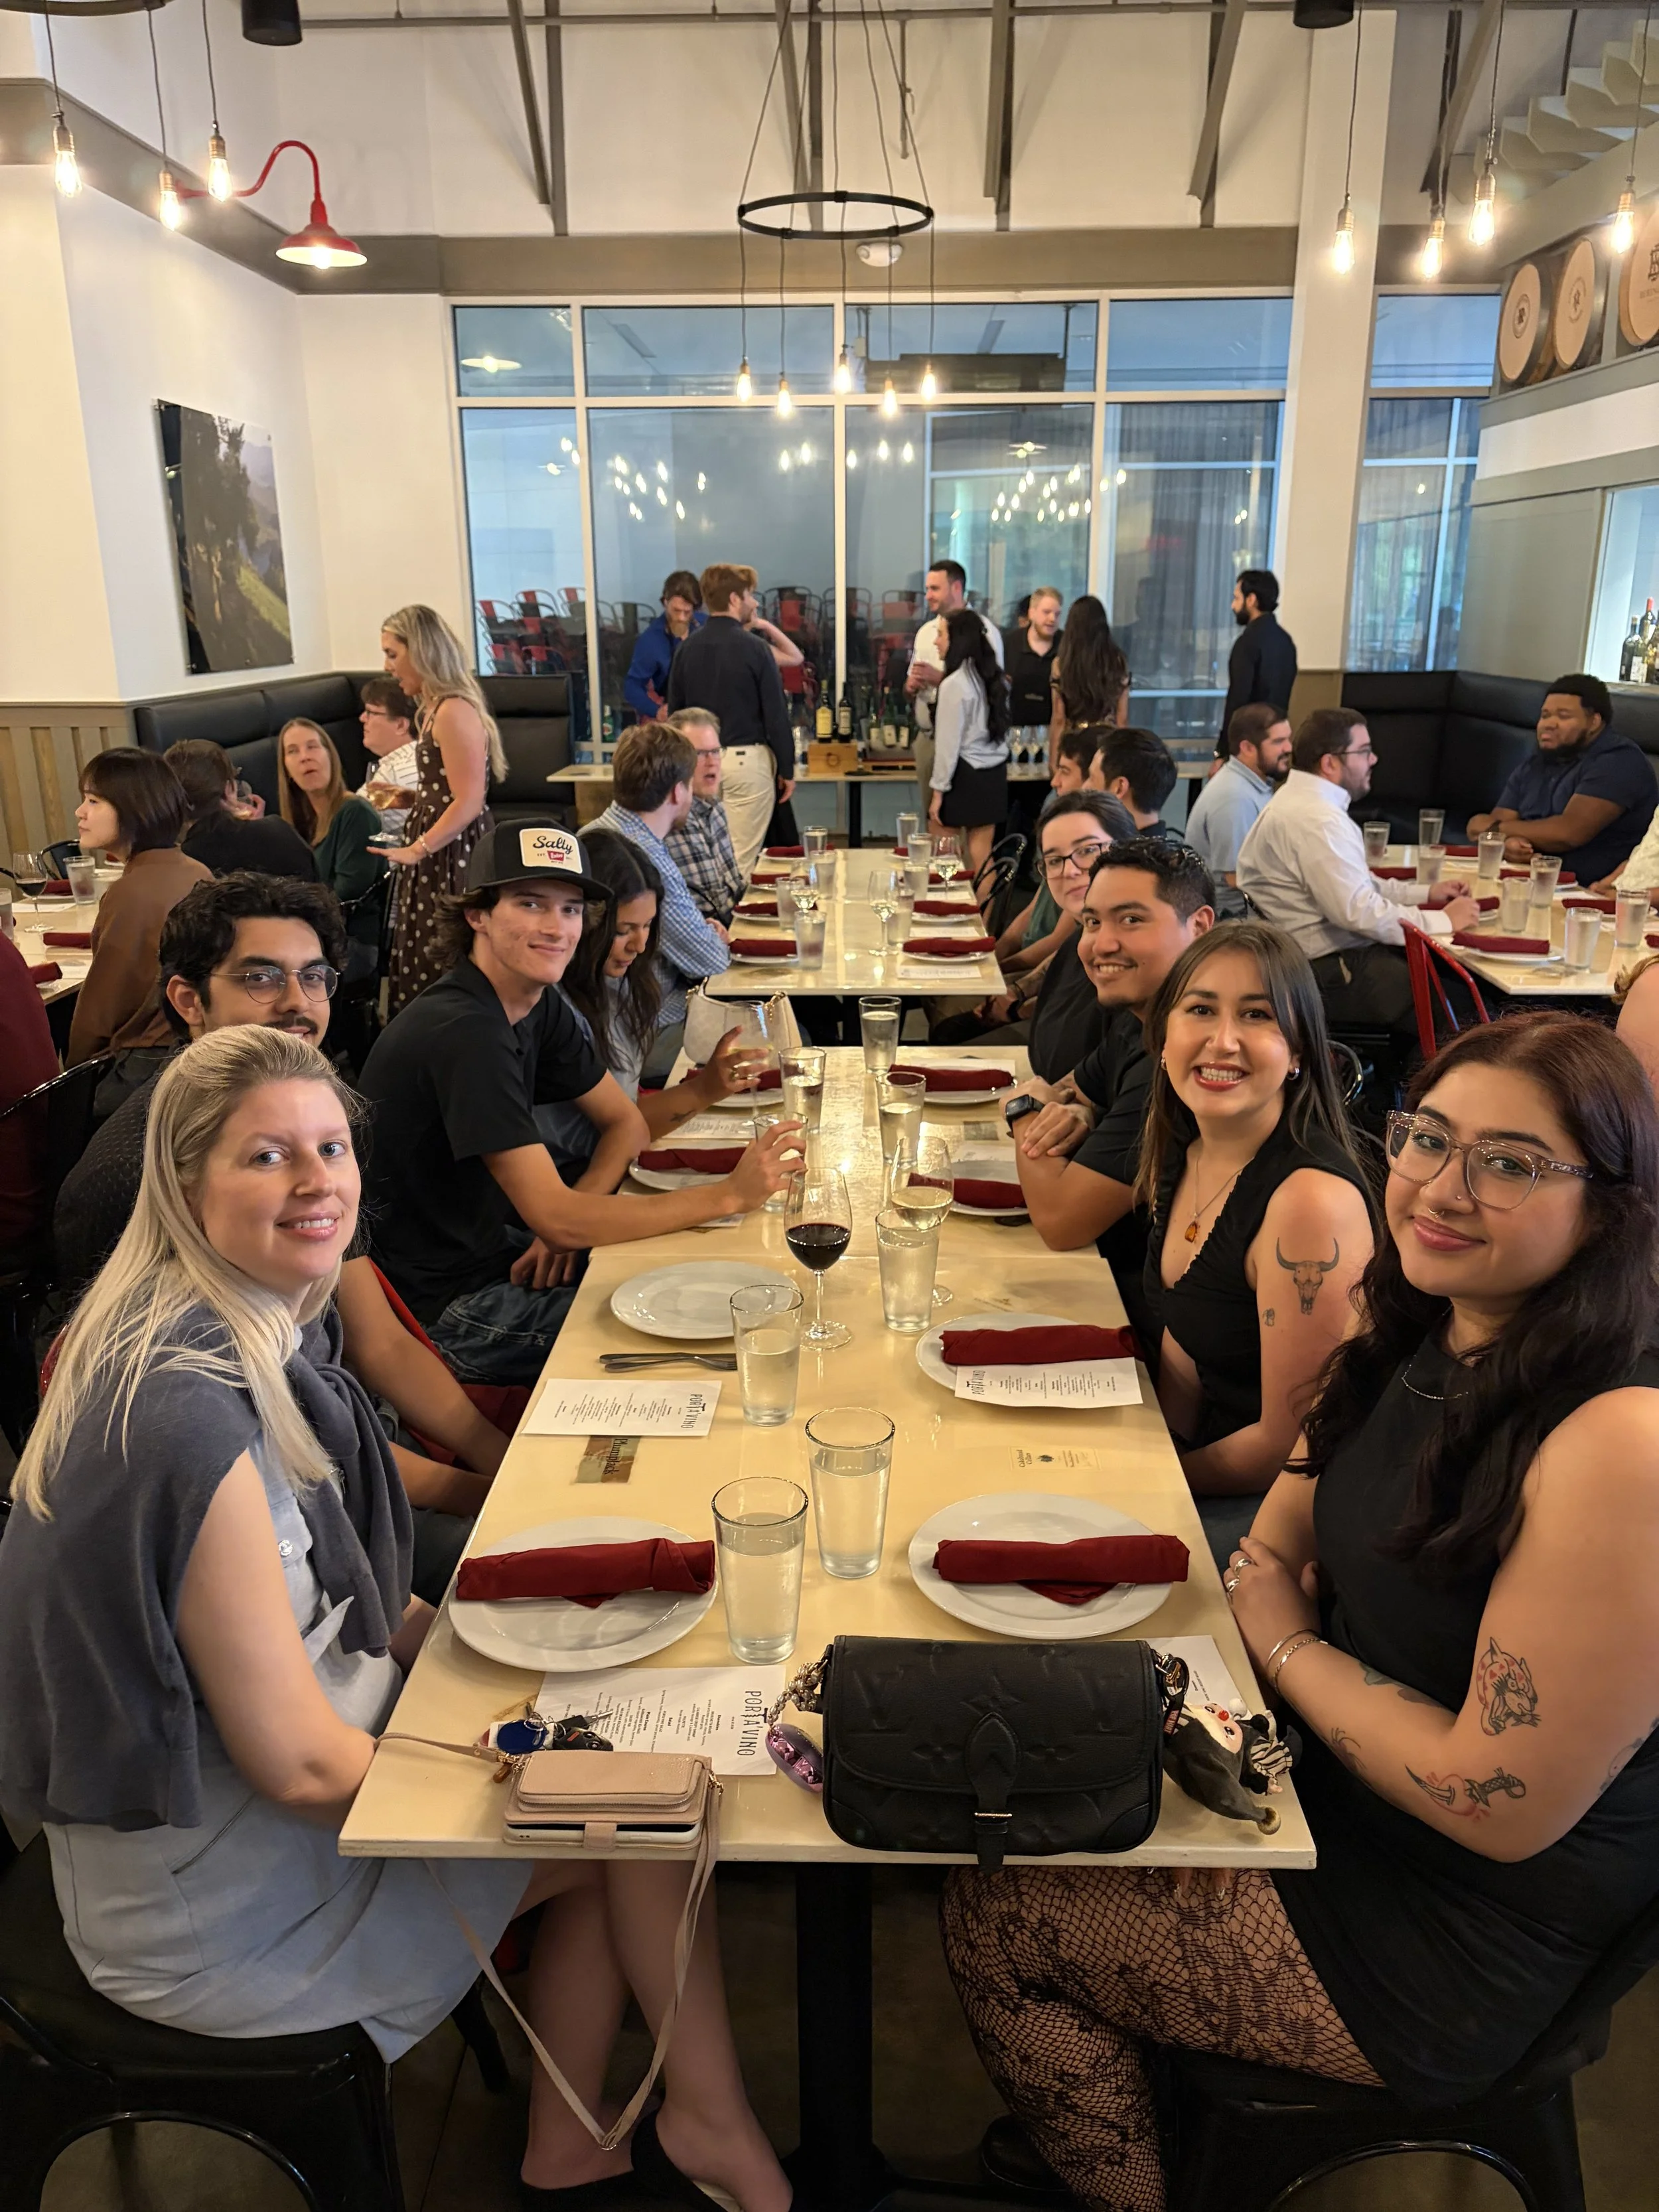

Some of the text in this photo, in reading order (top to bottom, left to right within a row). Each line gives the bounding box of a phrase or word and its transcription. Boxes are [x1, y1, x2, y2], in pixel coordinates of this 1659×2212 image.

[533, 836, 573, 854] Salty
[681, 1394, 706, 1428] PORTA'VINO
[603, 1438, 628, 1475] PlumpJack
[737, 1690, 768, 1756] PORTA'VINO
